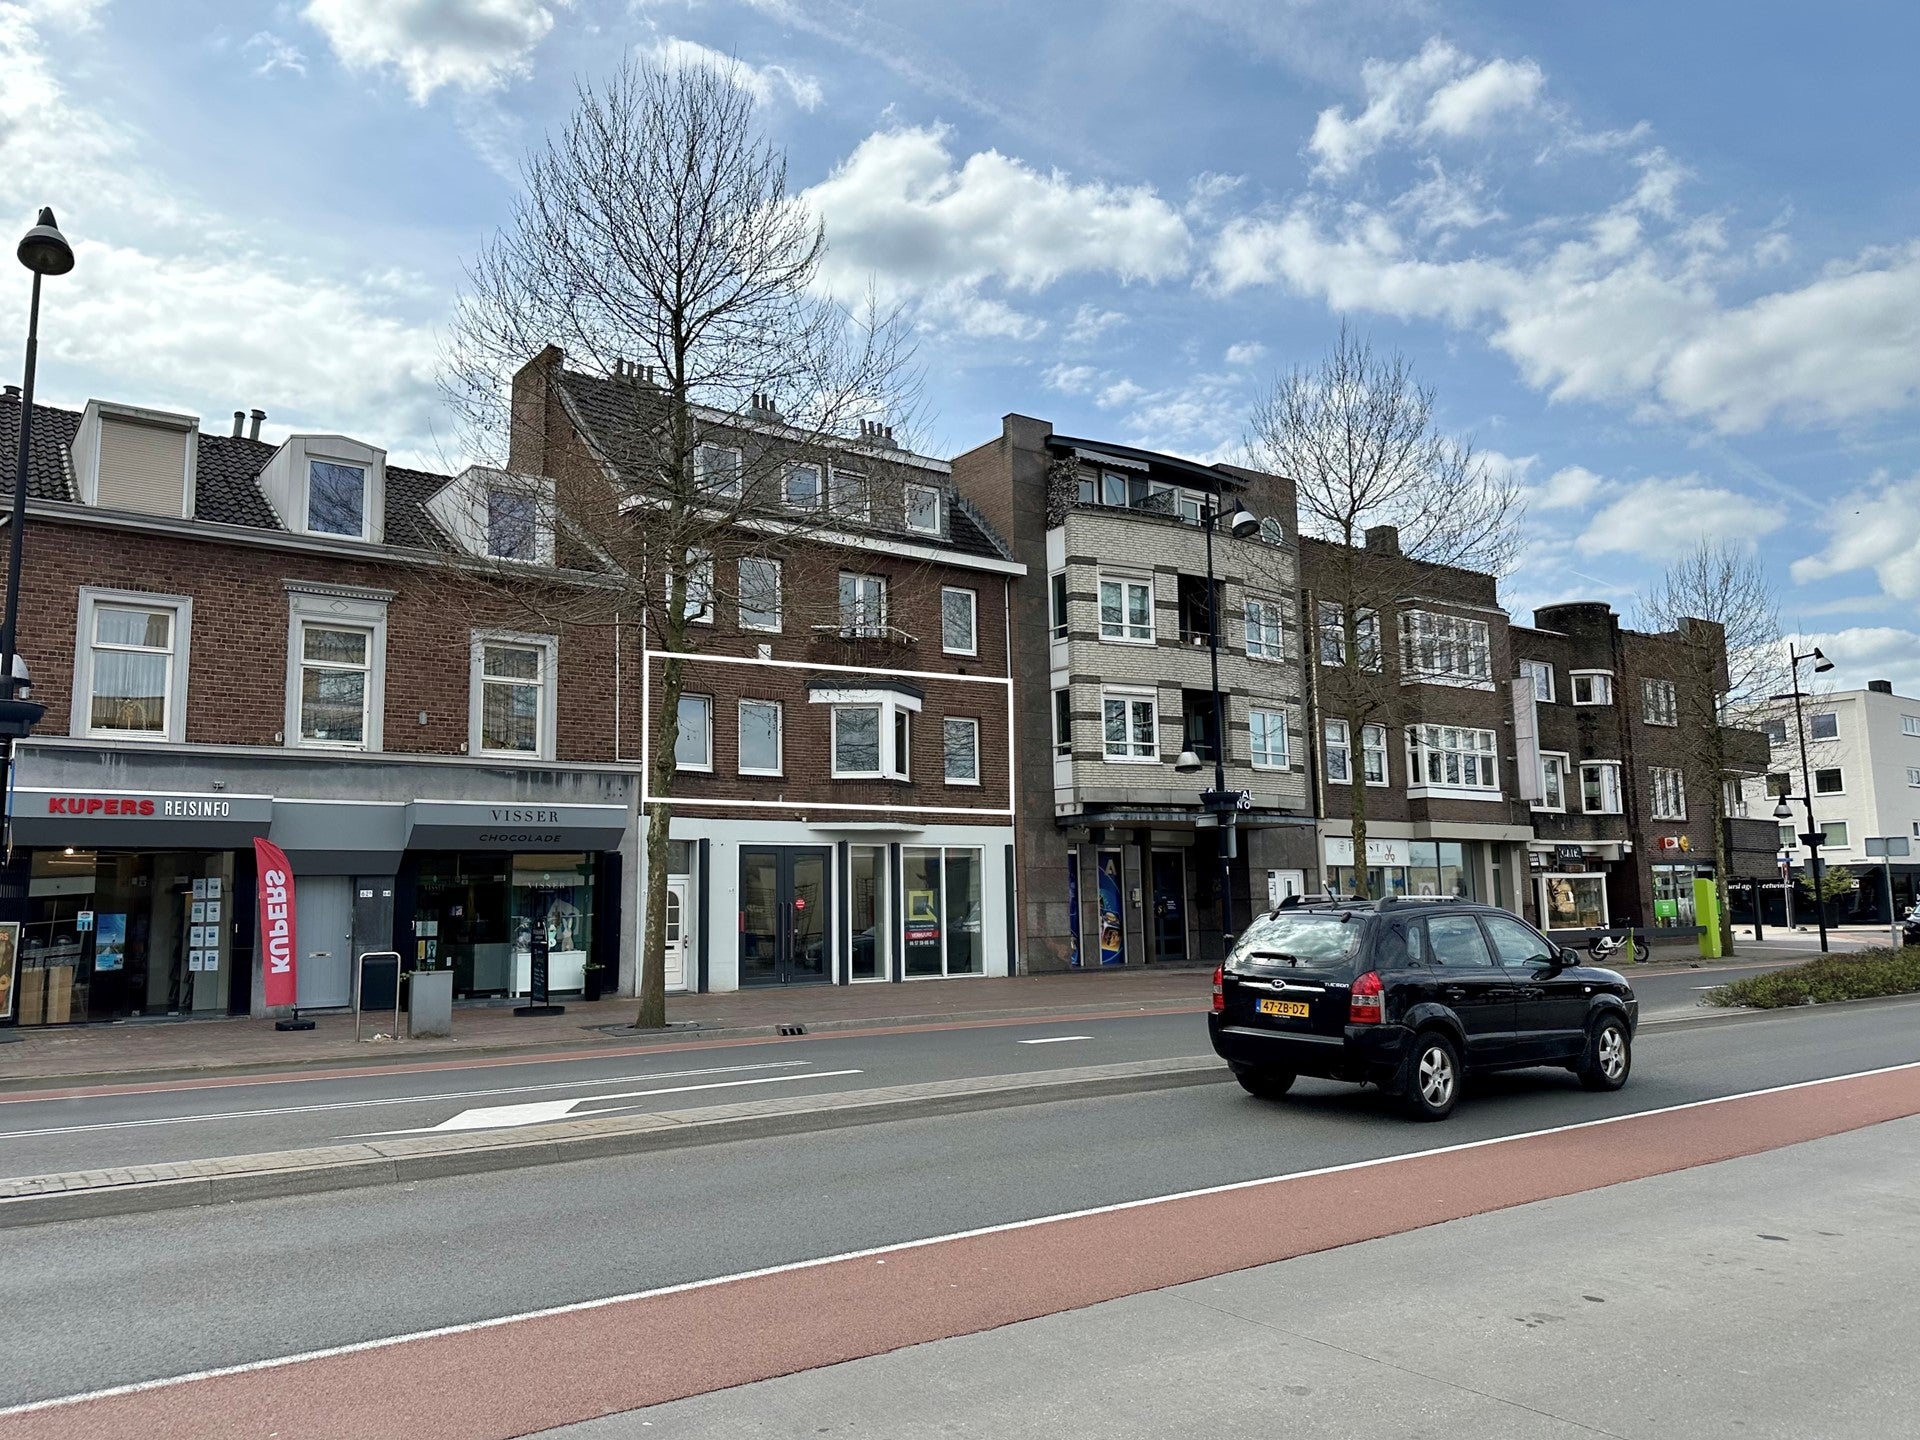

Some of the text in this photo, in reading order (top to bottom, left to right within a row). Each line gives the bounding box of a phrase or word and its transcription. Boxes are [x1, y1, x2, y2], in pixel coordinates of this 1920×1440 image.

[48, 797, 230, 817] KUPERS REISINFO
[491, 809, 559, 822] VISSER
[479, 834, 562, 843] CHOCOLADE
[1263, 1001, 1306, 1015] 47-ZB-DZ
